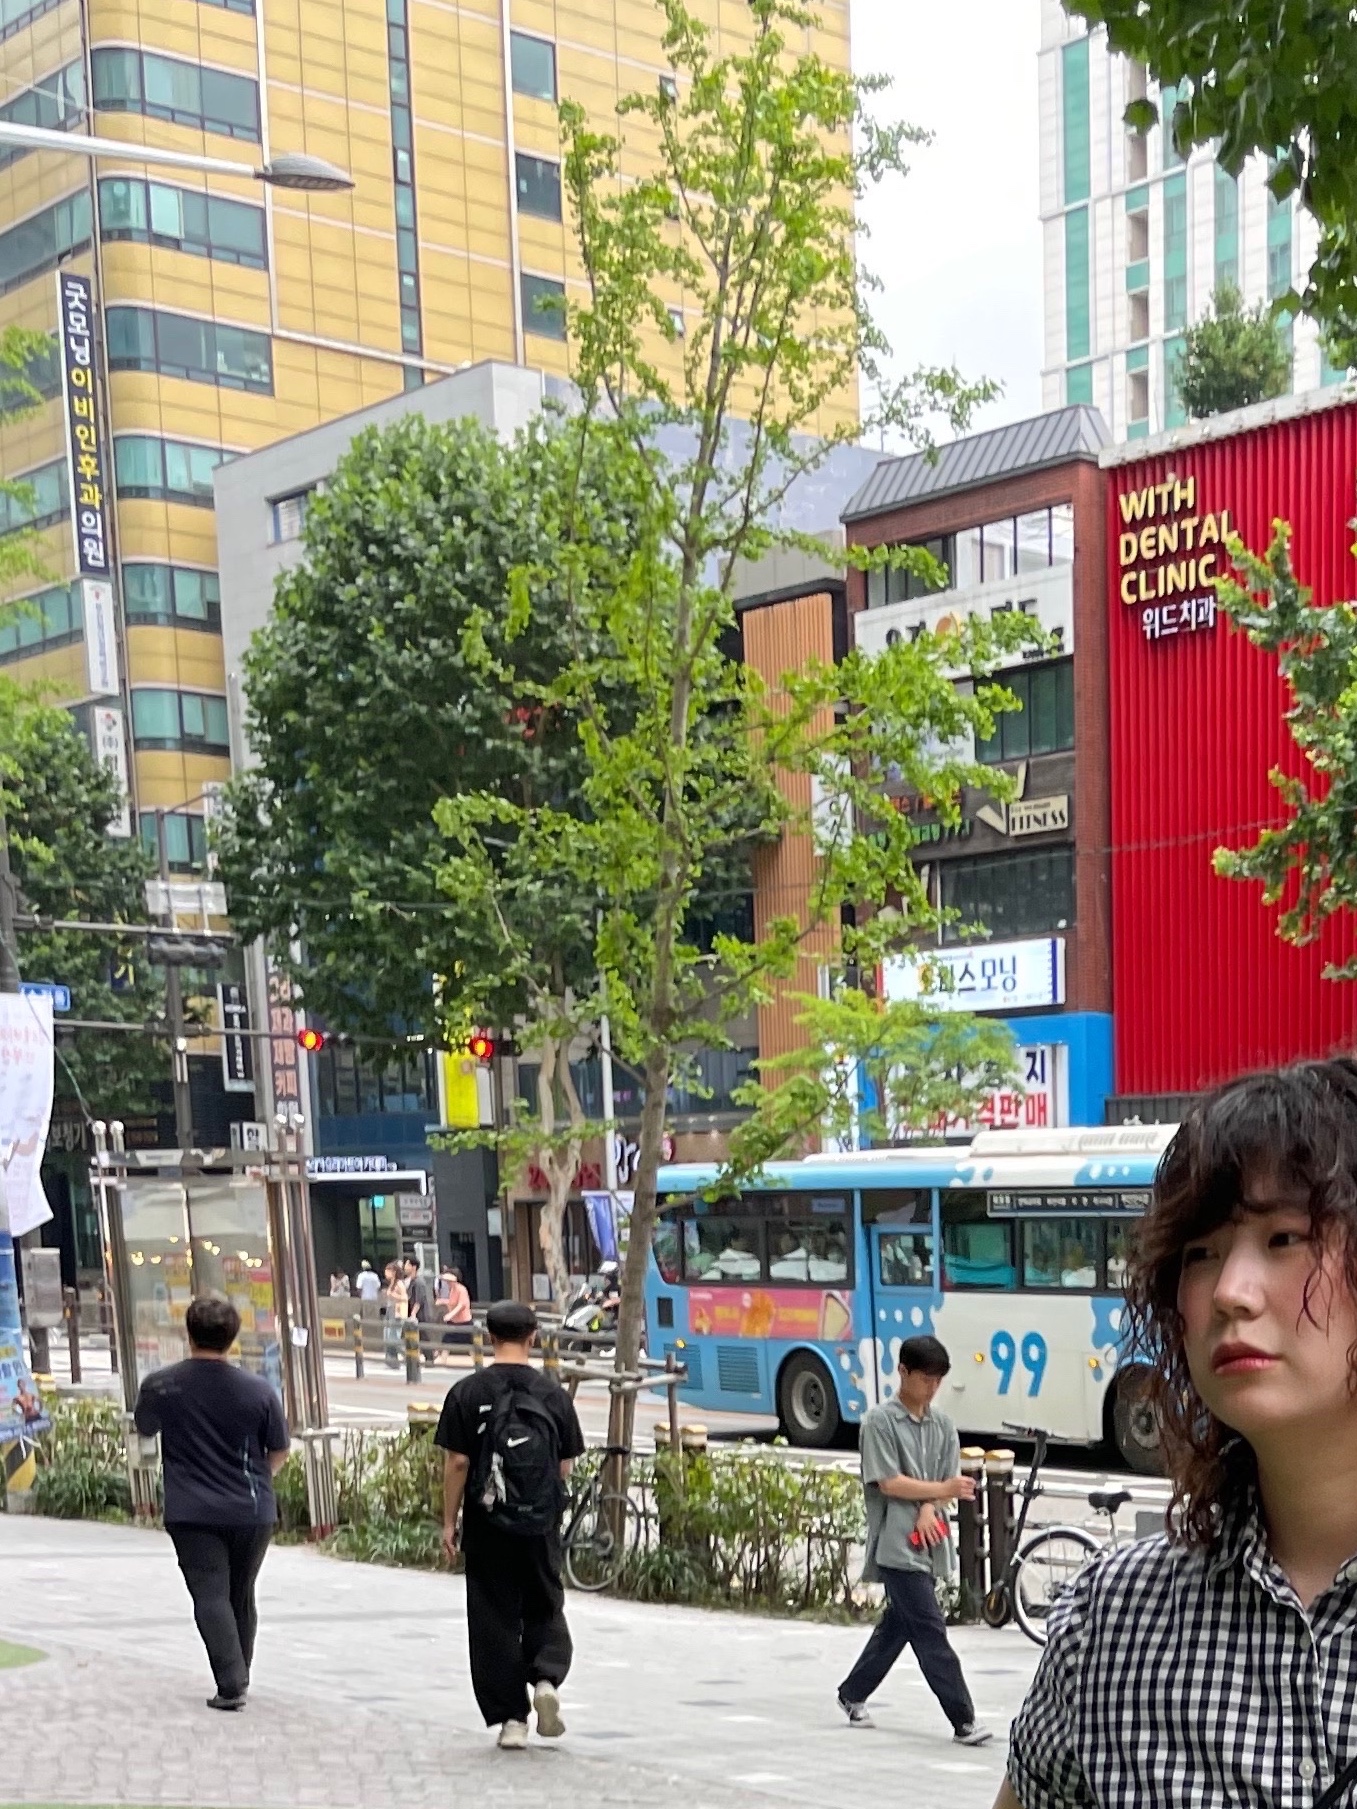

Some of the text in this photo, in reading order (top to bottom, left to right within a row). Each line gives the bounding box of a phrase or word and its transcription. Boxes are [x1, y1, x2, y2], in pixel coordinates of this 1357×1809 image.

[1118, 475, 1195, 524] WITH
[1119, 509, 1239, 567] DENTAL
[1120, 553, 1217, 605] CLINIC
[1142, 595, 1217, 640] 위드치과
[990, 1330, 1047, 1397] 99
